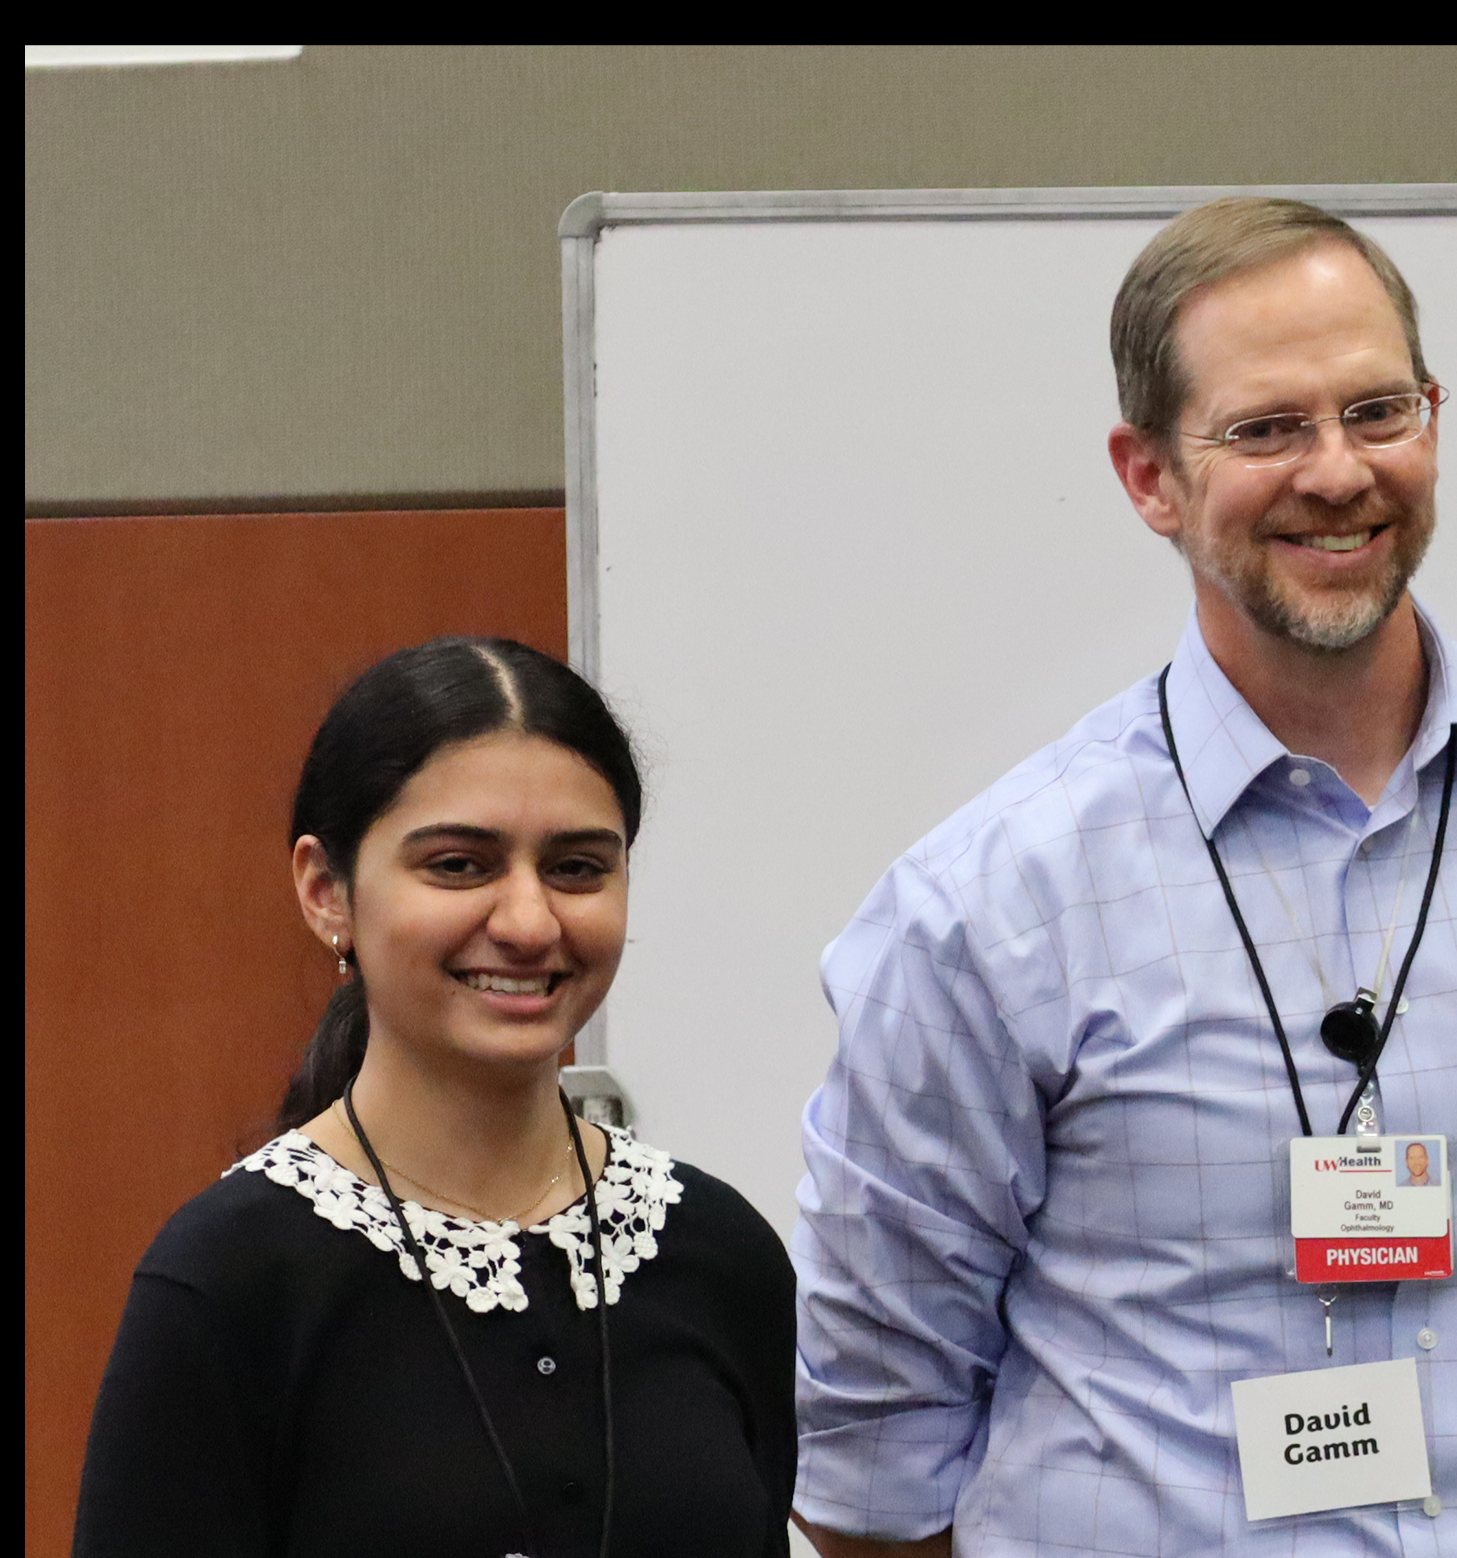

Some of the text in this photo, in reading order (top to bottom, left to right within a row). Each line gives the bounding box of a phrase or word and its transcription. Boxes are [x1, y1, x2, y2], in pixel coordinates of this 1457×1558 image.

[1355, 1189, 1381, 1200] David
[1343, 1200, 1394, 1211] Gamm, MD
[1354, 1213, 1381, 1223] Faculty
[1340, 1223, 1395, 1233] Ophthalmology
[1326, 1246, 1419, 1267] PHYSICIAN
[1284, 1402, 1372, 1436] David
[1284, 1437, 1380, 1466] Gamm
